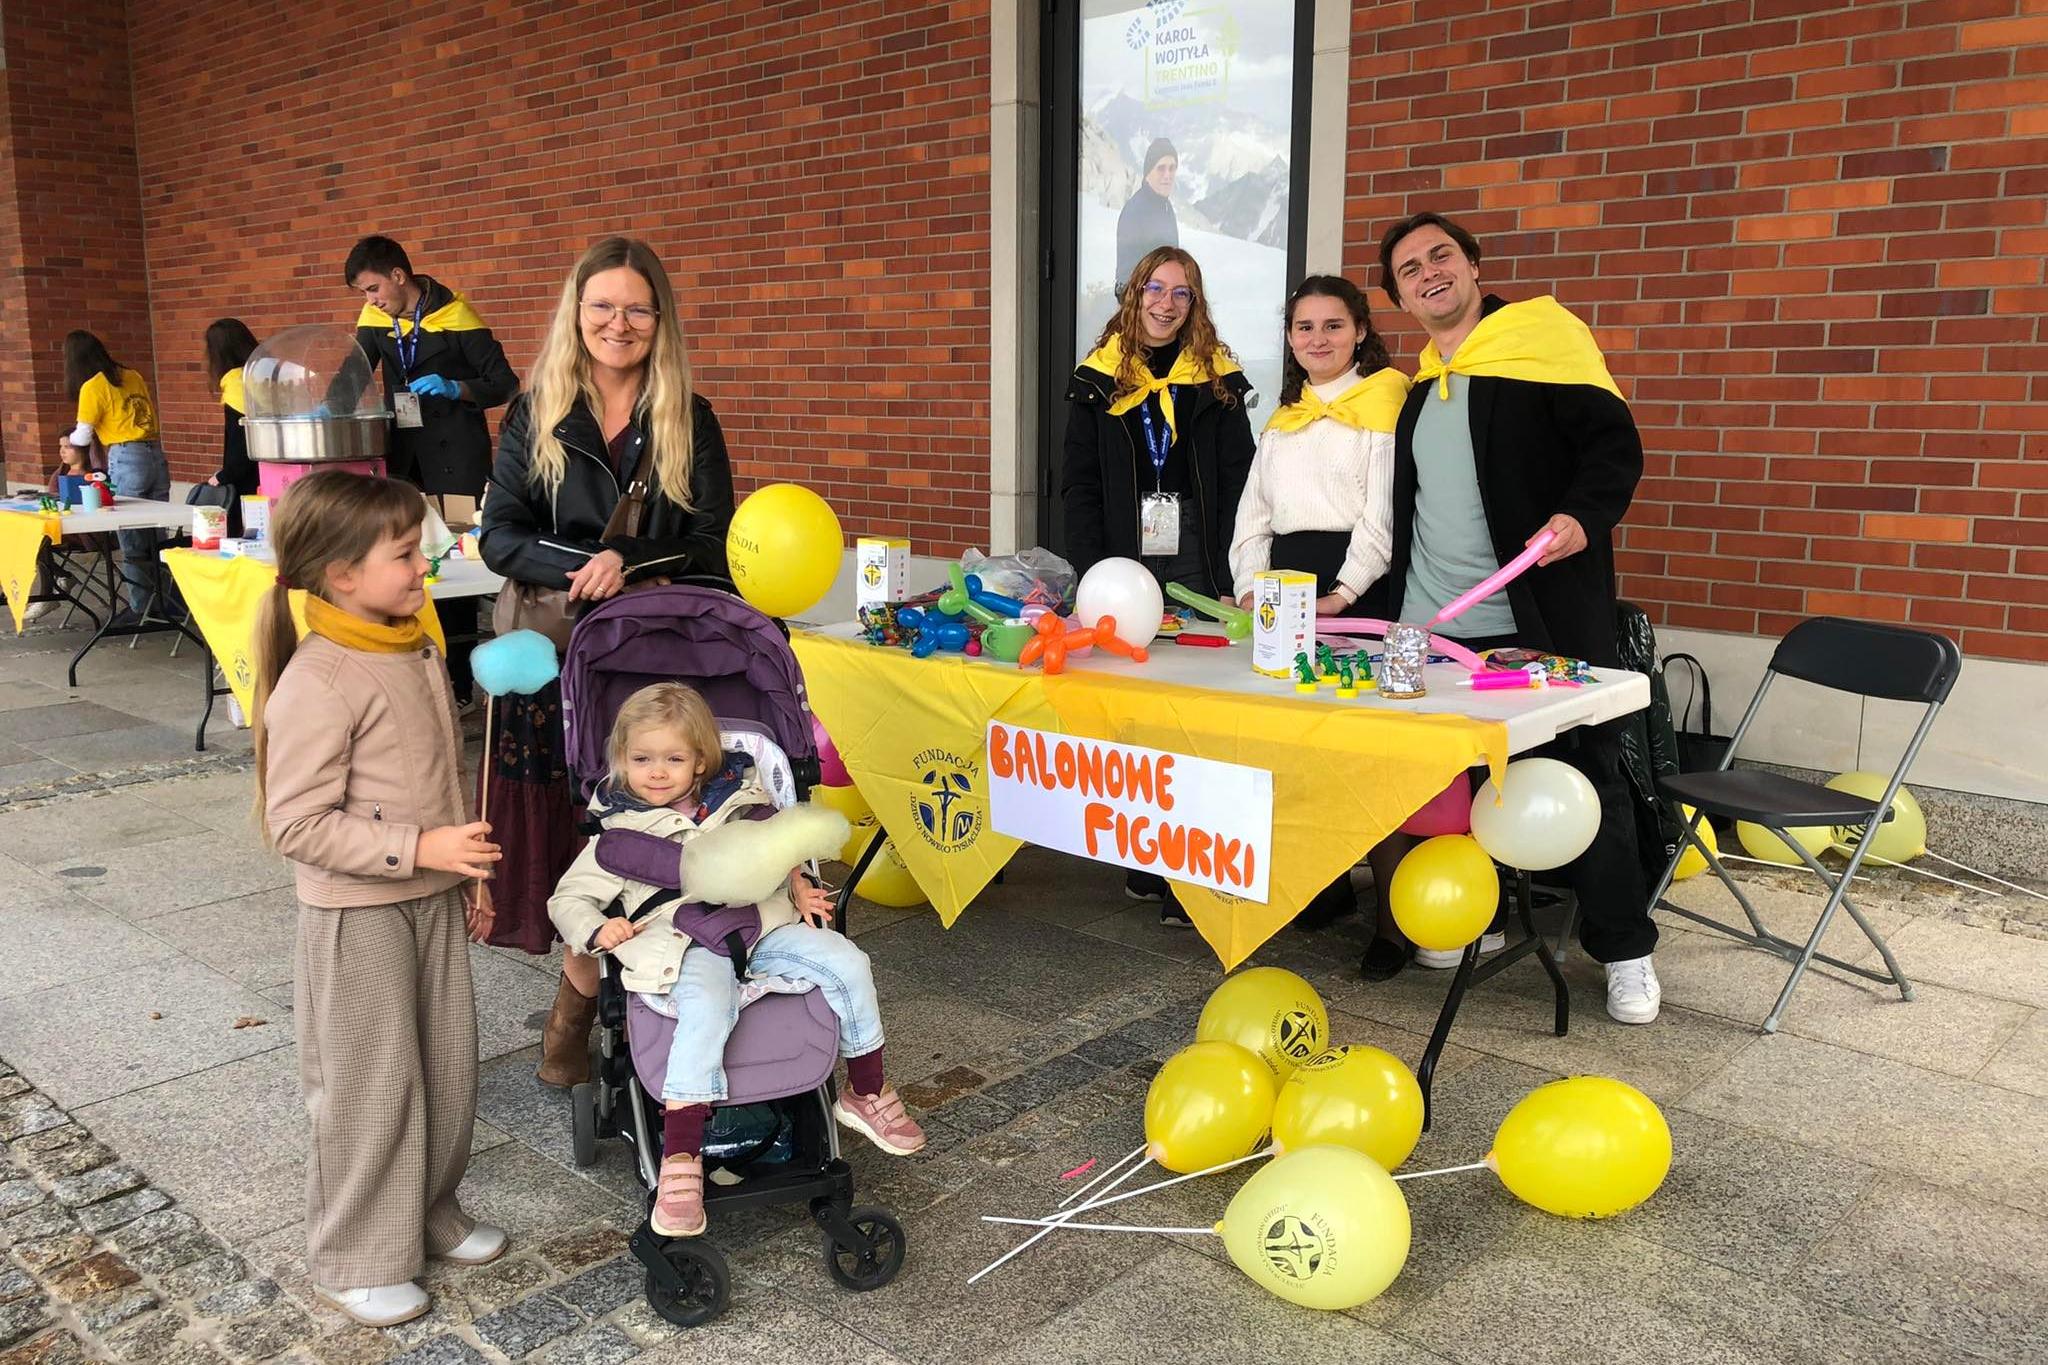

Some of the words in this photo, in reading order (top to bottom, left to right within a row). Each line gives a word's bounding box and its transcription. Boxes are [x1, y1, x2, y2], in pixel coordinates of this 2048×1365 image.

[1156, 27, 1197, 46] KAROL
[1155, 43, 1210, 65] WOJTYŁA
[1155, 62, 1218, 84] TRENTINO
[913, 748, 980, 778] FUNDACJA
[990, 725, 1175, 811] BALONOWE
[1085, 802, 1255, 888] FIGURKI
[1311, 1212, 1338, 1276] FUNDACJA
